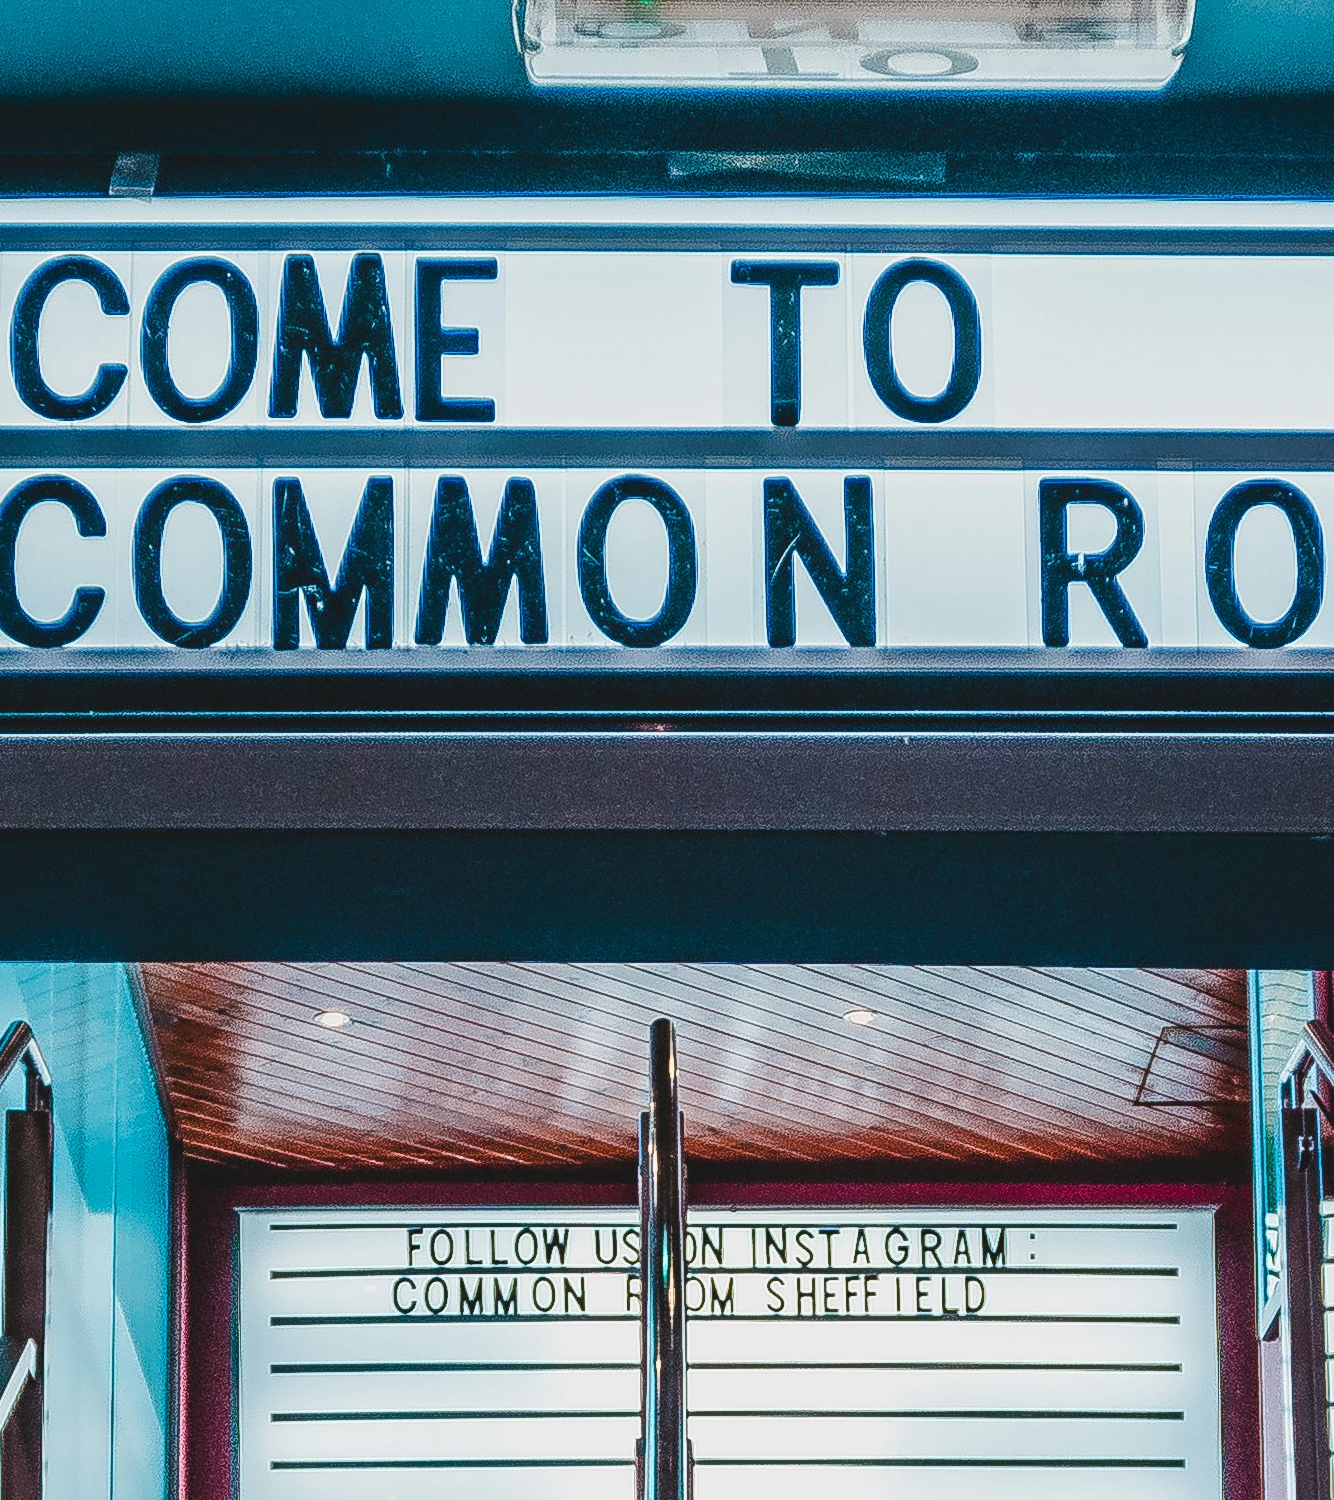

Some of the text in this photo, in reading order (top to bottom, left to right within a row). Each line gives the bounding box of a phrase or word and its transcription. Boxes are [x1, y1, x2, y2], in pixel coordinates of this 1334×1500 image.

[731, 260, 981, 426] TO
[406, 1227, 570, 1267] FOLLOW
[594, 1228, 641, 1265] US
[392, 1274, 987, 1315] COMMON ROM SHEFFIELD
